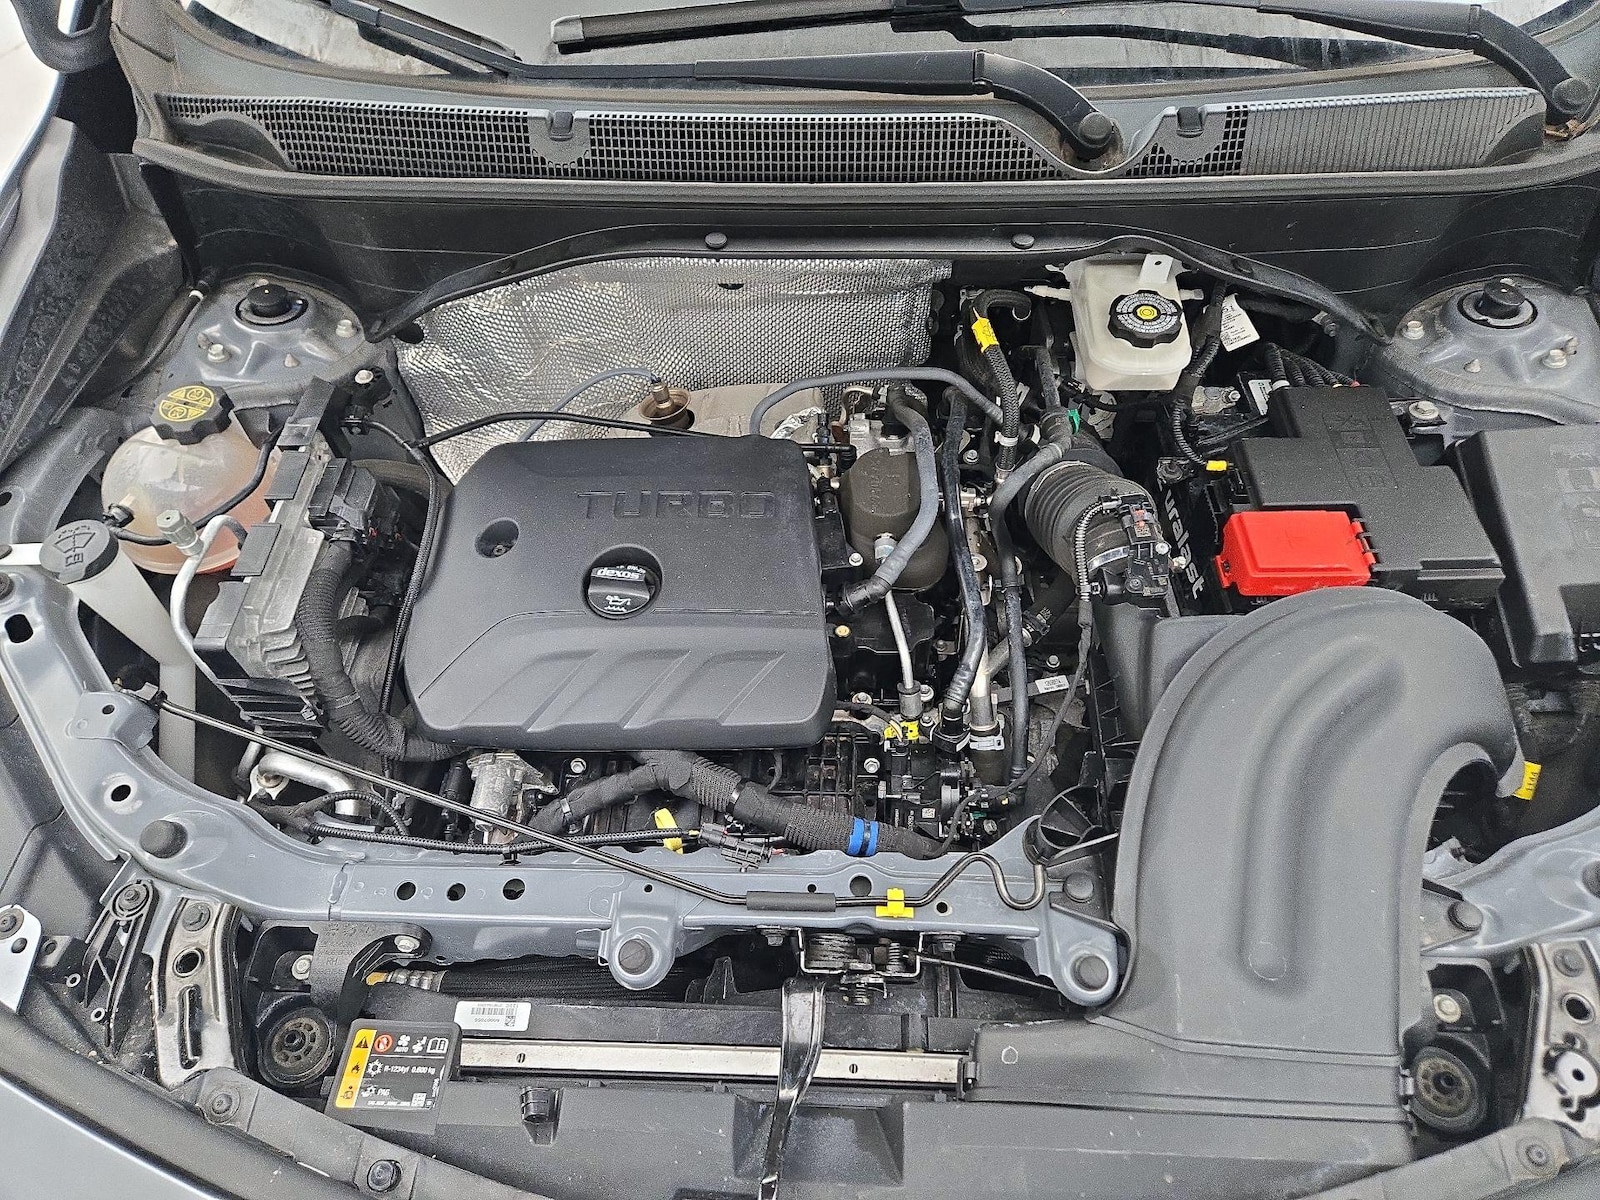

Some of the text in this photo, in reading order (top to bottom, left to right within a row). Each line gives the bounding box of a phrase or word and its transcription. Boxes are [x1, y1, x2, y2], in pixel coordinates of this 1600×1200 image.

[577, 490, 775, 519] TURBO
[1157, 476, 1204, 600] uralast
[596, 566, 641, 580] dexos
